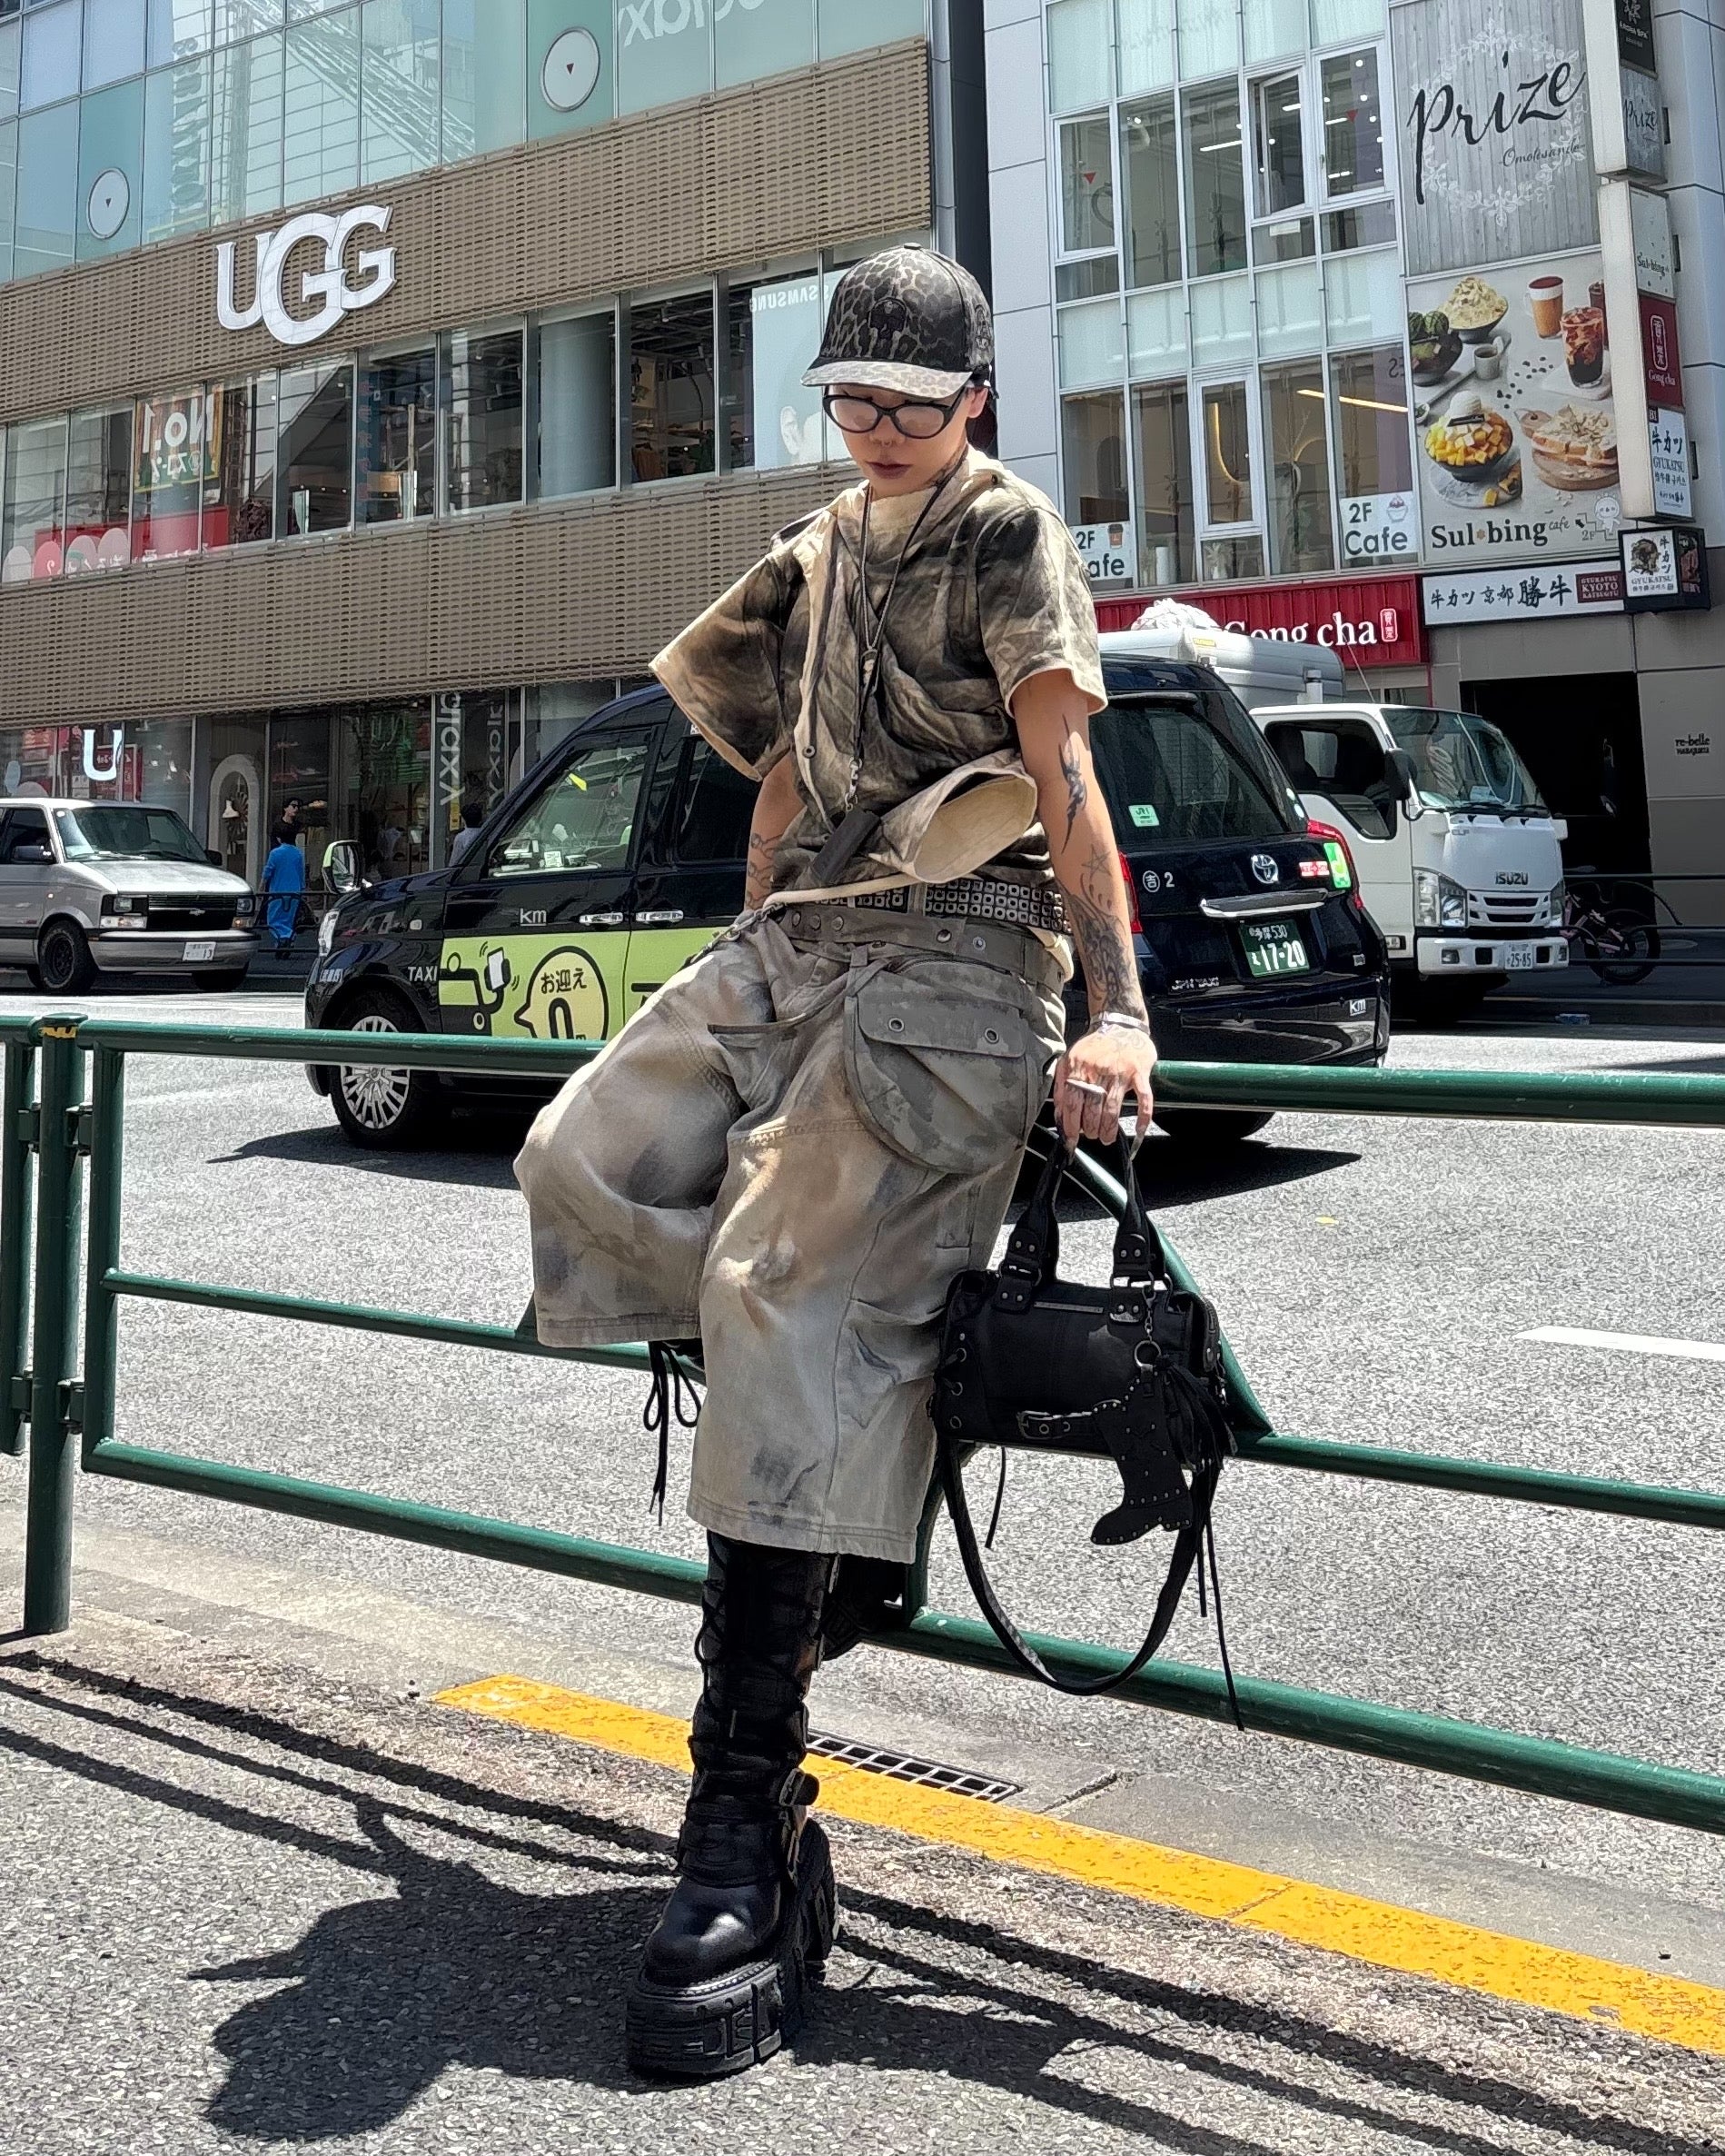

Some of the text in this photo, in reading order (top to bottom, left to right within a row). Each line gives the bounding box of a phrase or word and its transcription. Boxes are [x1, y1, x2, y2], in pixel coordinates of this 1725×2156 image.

[1407, 51, 1586, 205] Prize
[1622, 99, 1657, 142] Prize
[216, 204, 398, 345] UGG
[1652, 426, 1682, 454] 牛カツ
[1653, 456, 1684, 472] GYUKATSU
[1349, 502, 1373, 523] 2F
[1076, 531, 1095, 550] 2F
[1345, 526, 1408, 555] Cafe
[1089, 553, 1125, 578] afe
[1660, 536, 1671, 573] 牛カツ
[1581, 581, 1619, 592] KYOTO
[1317, 611, 1377, 647] cha
[1164, 871, 1175, 888] 2
[1495, 872, 1529, 886] ISUZU
[520, 908, 547, 924] km
[408, 966, 437, 982] TAXI
[540, 968, 588, 994] お迎え
